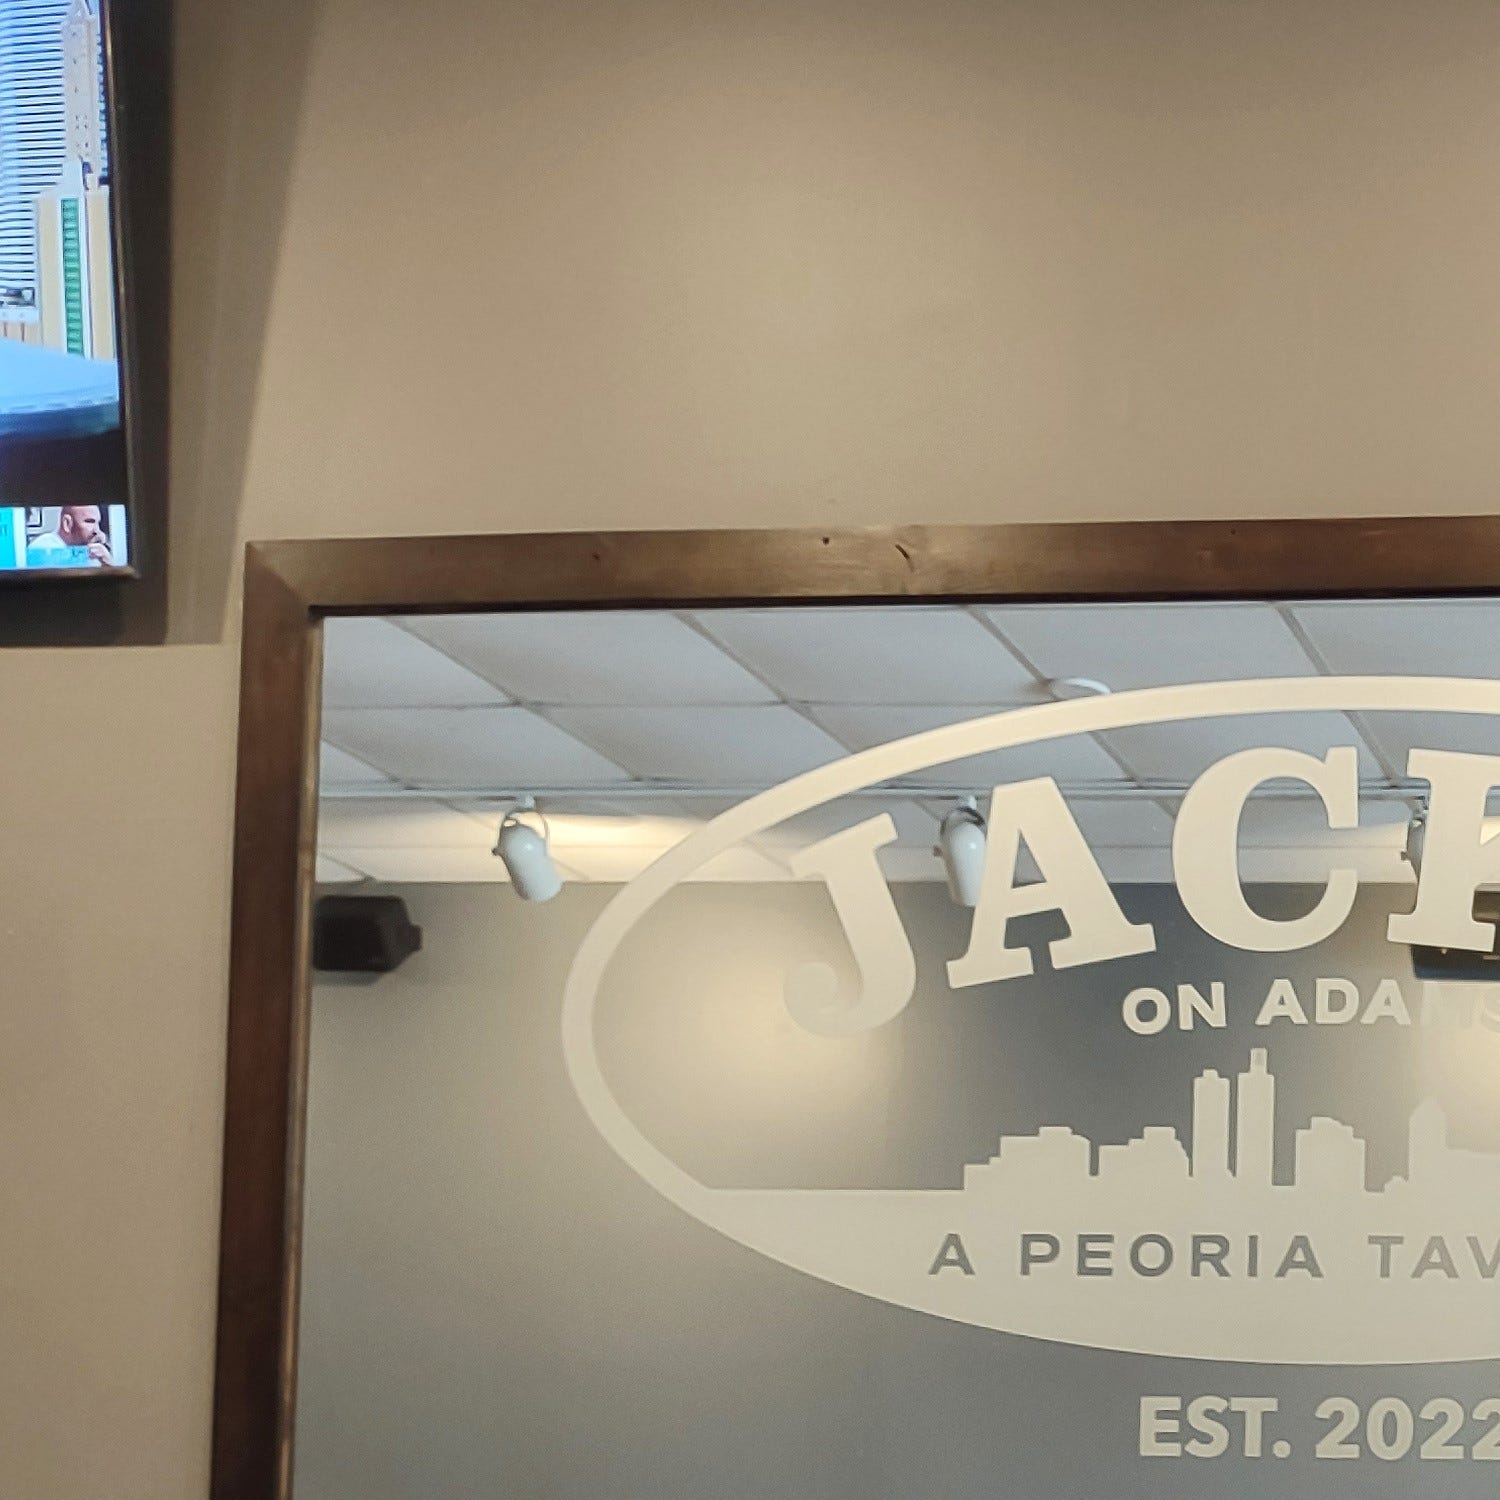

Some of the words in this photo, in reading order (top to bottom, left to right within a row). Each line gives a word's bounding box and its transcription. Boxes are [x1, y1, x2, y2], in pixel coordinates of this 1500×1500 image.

[1122, 982, 1228, 1035] ON
[928, 1233, 976, 1276] A
[1019, 1233, 1325, 1278] PEORIA
[1139, 1395, 1291, 1459] EST.
